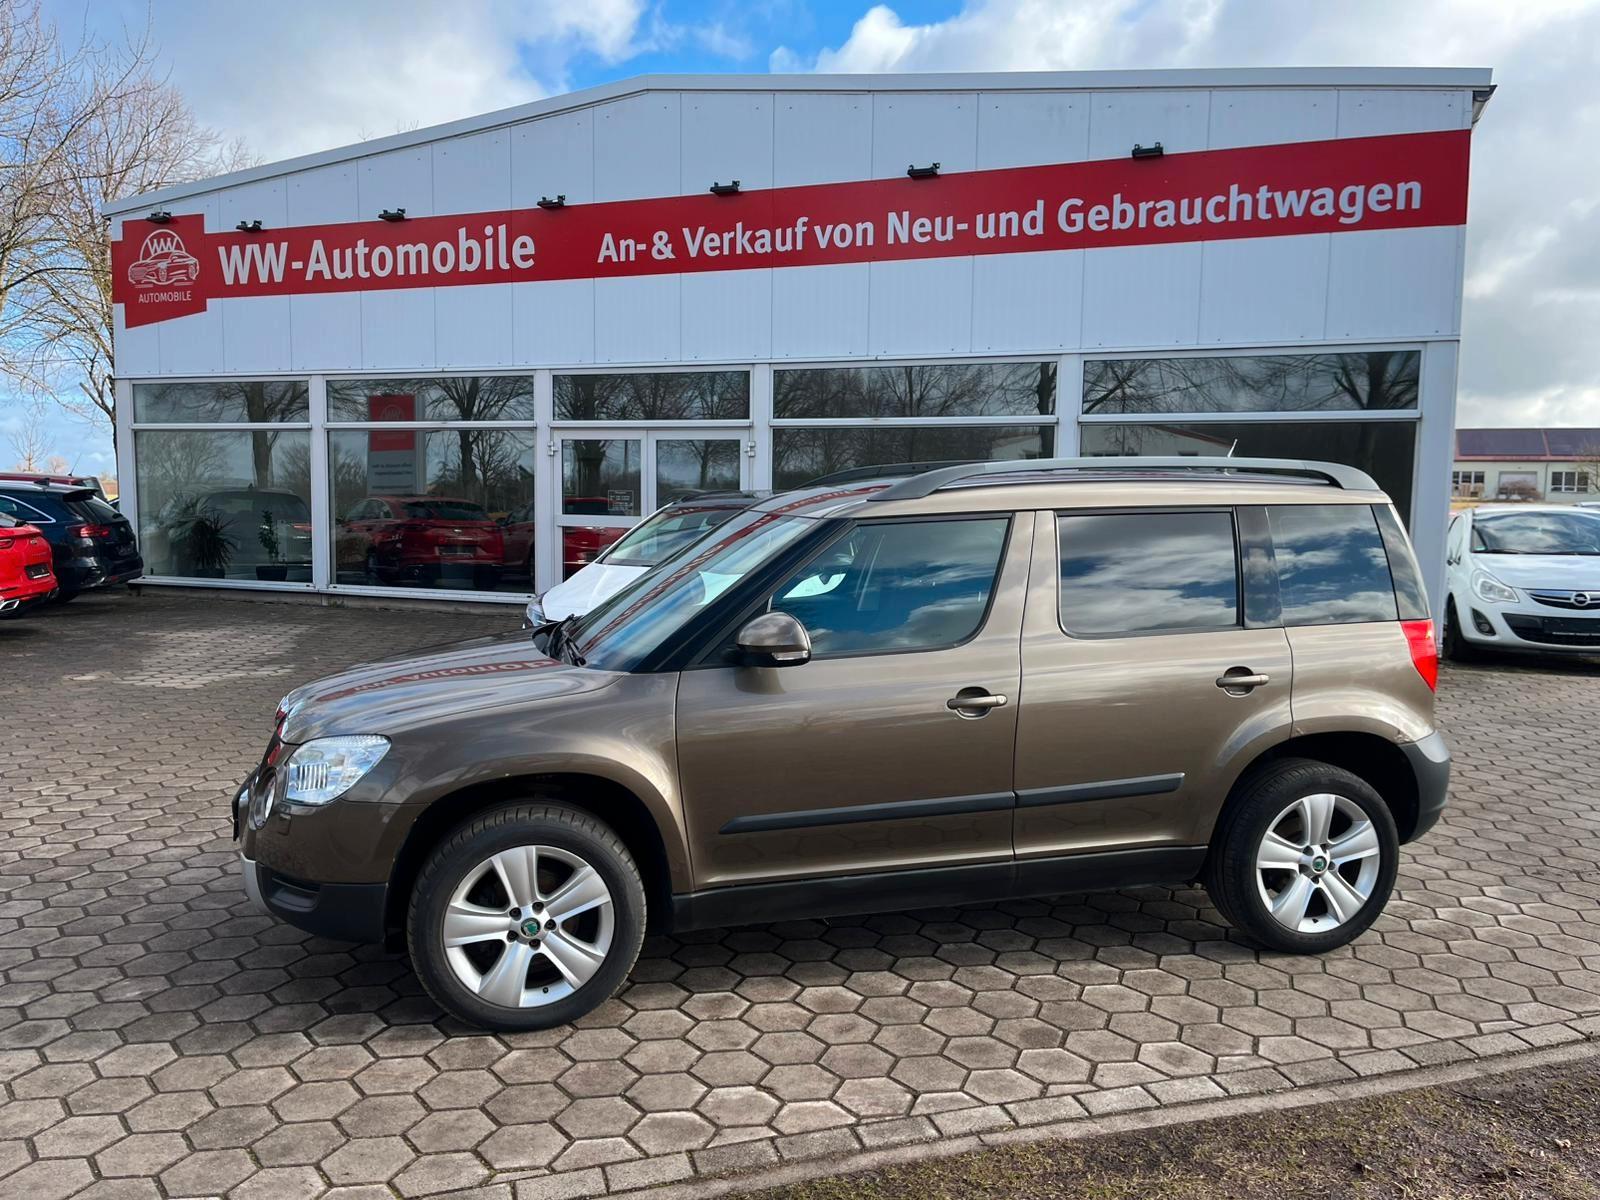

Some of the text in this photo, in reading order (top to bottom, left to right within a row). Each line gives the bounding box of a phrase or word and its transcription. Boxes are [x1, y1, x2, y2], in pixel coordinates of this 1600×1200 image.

[651, 230, 676, 260] &
[682, 216, 808, 258] Verkauf
[813, 221, 874, 249] von
[1057, 180, 1422, 233] Gebrauchtwagen
[217, 223, 535, 286] WW-Automobile
[138, 290, 192, 304] AUTOMOBILE
